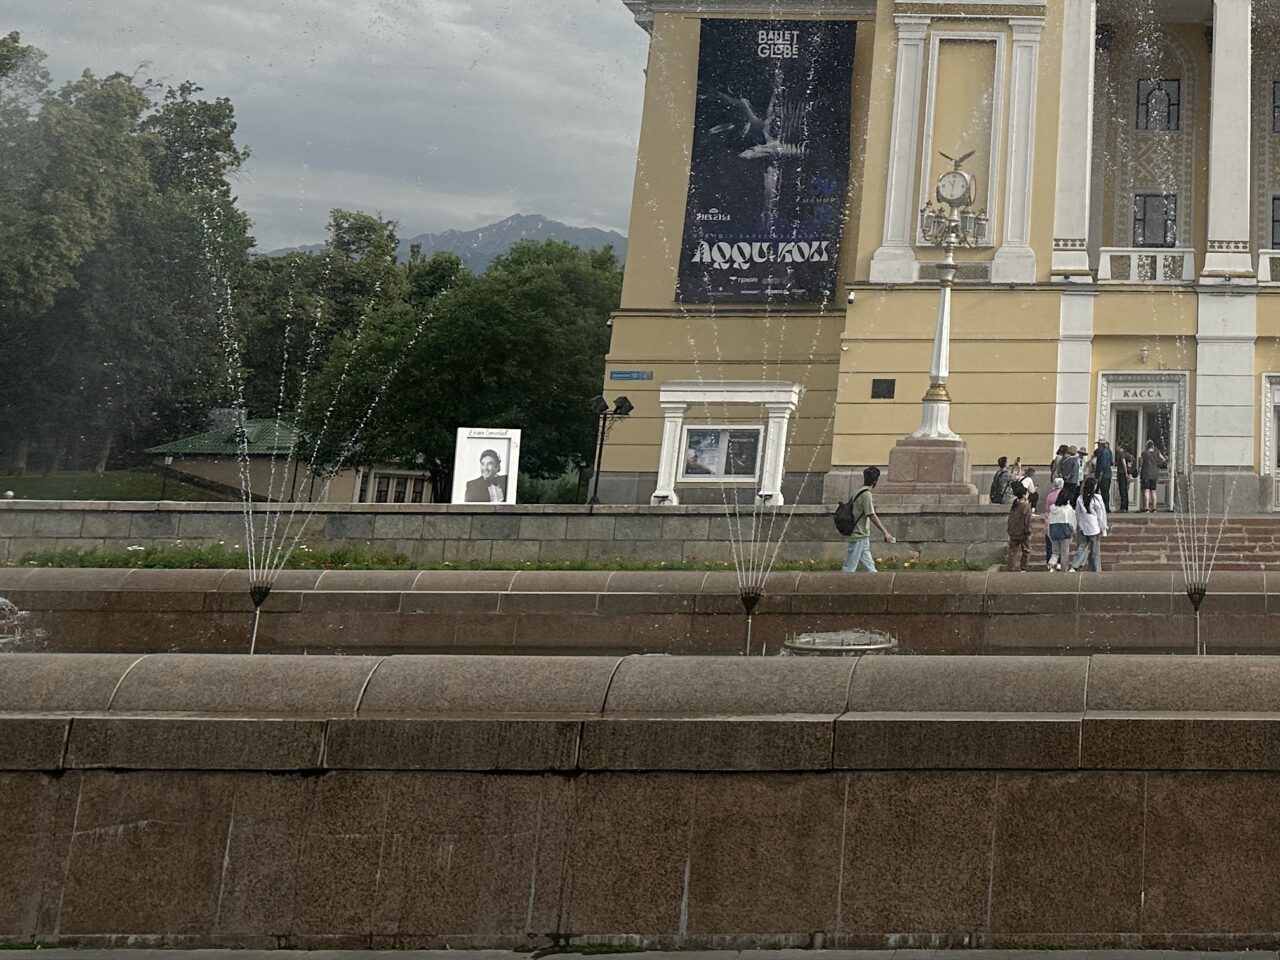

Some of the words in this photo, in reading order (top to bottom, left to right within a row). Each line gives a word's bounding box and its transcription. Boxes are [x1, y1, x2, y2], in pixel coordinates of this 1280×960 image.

[758, 30, 799, 44] BALLET
[757, 44, 799, 58] GLOBE
[692, 241, 770, 270] AQQU
[1123, 389, 1162, 398] КАССА
